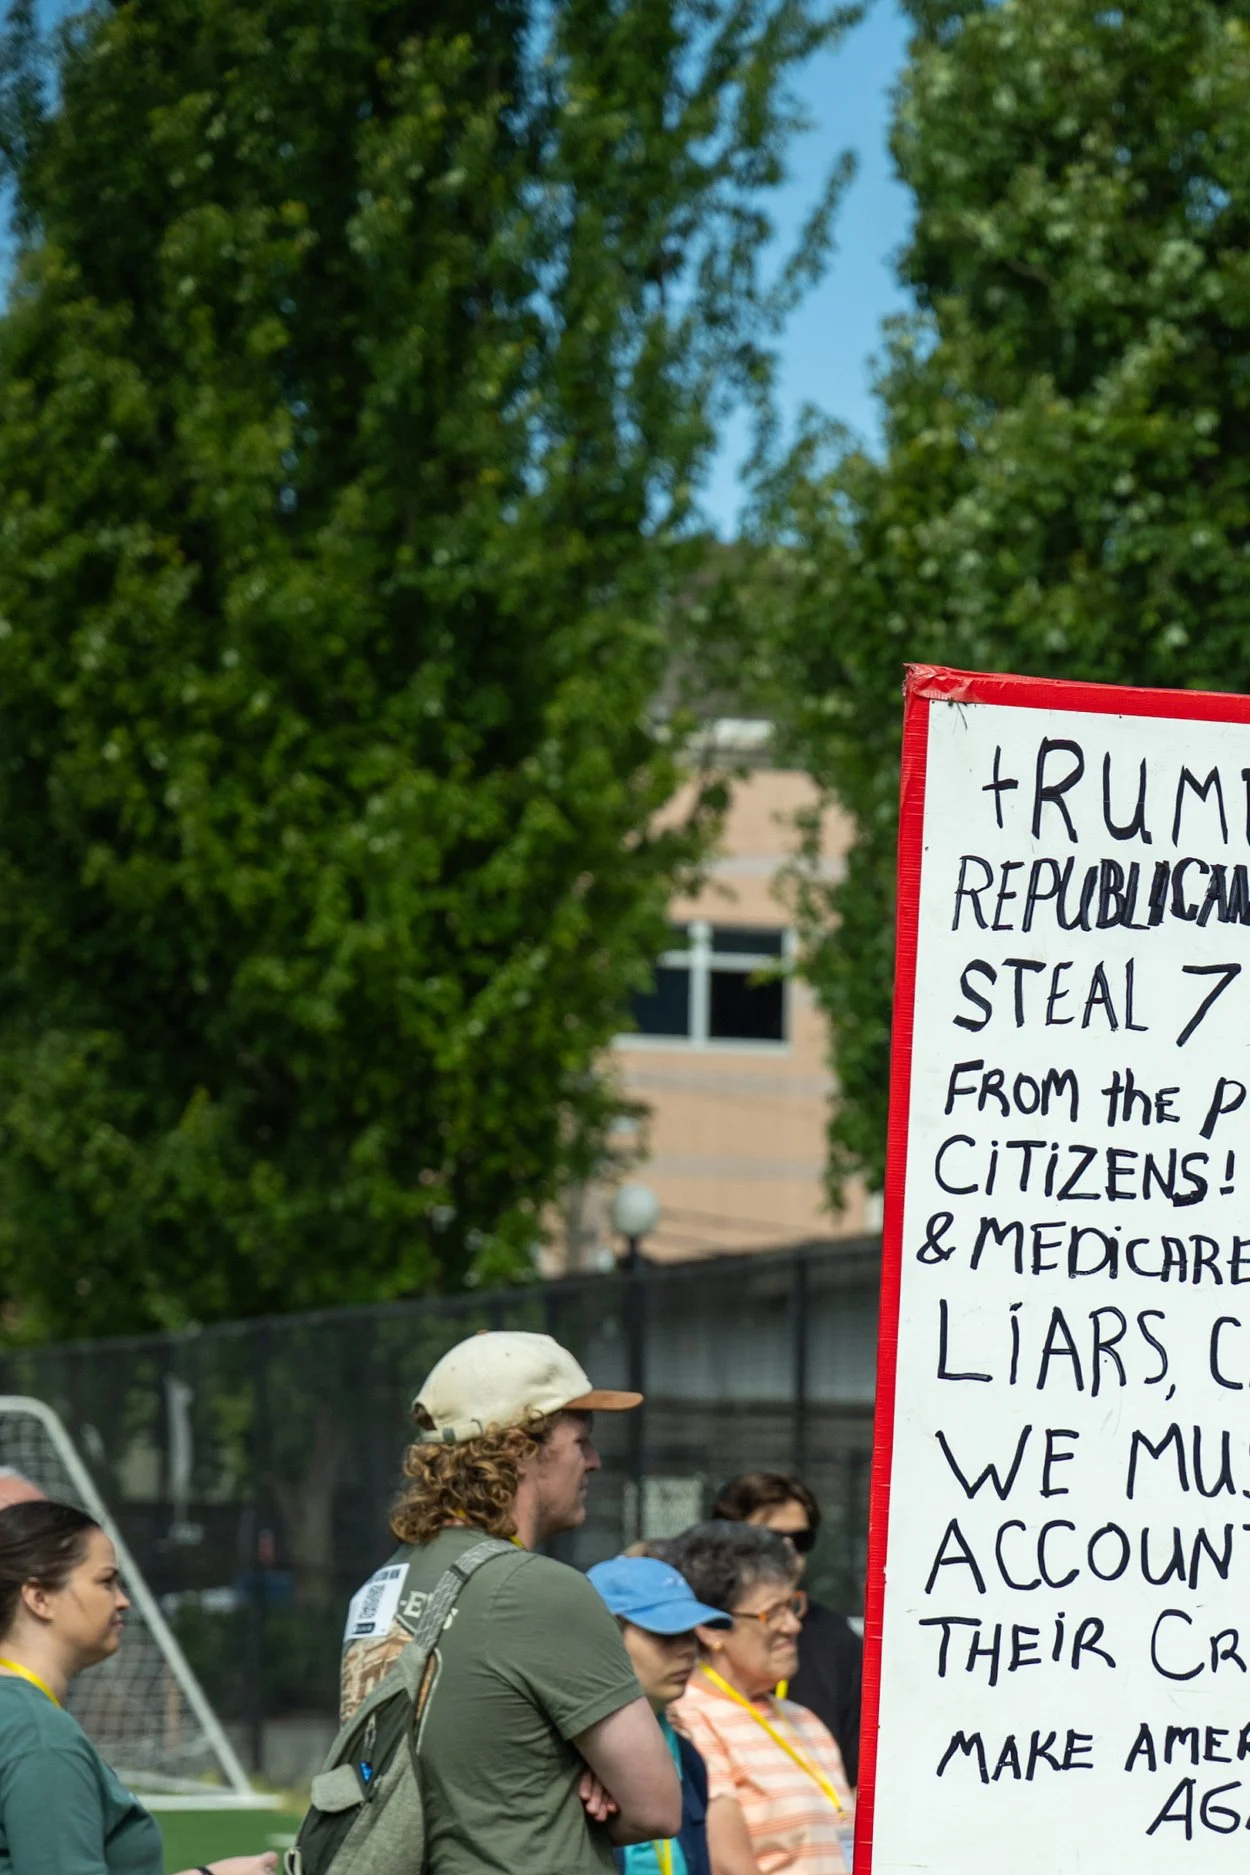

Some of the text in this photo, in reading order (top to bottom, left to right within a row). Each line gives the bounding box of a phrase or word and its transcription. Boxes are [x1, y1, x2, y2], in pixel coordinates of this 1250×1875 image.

[952, 957, 1149, 1033] STEAL
[1175, 962, 1242, 1048] 7
[944, 1058, 1079, 1123] FROM
[916, 1211, 957, 1265] &
[934, 1424, 1080, 1501] WE
[936, 1728, 1094, 1785] MAKE
